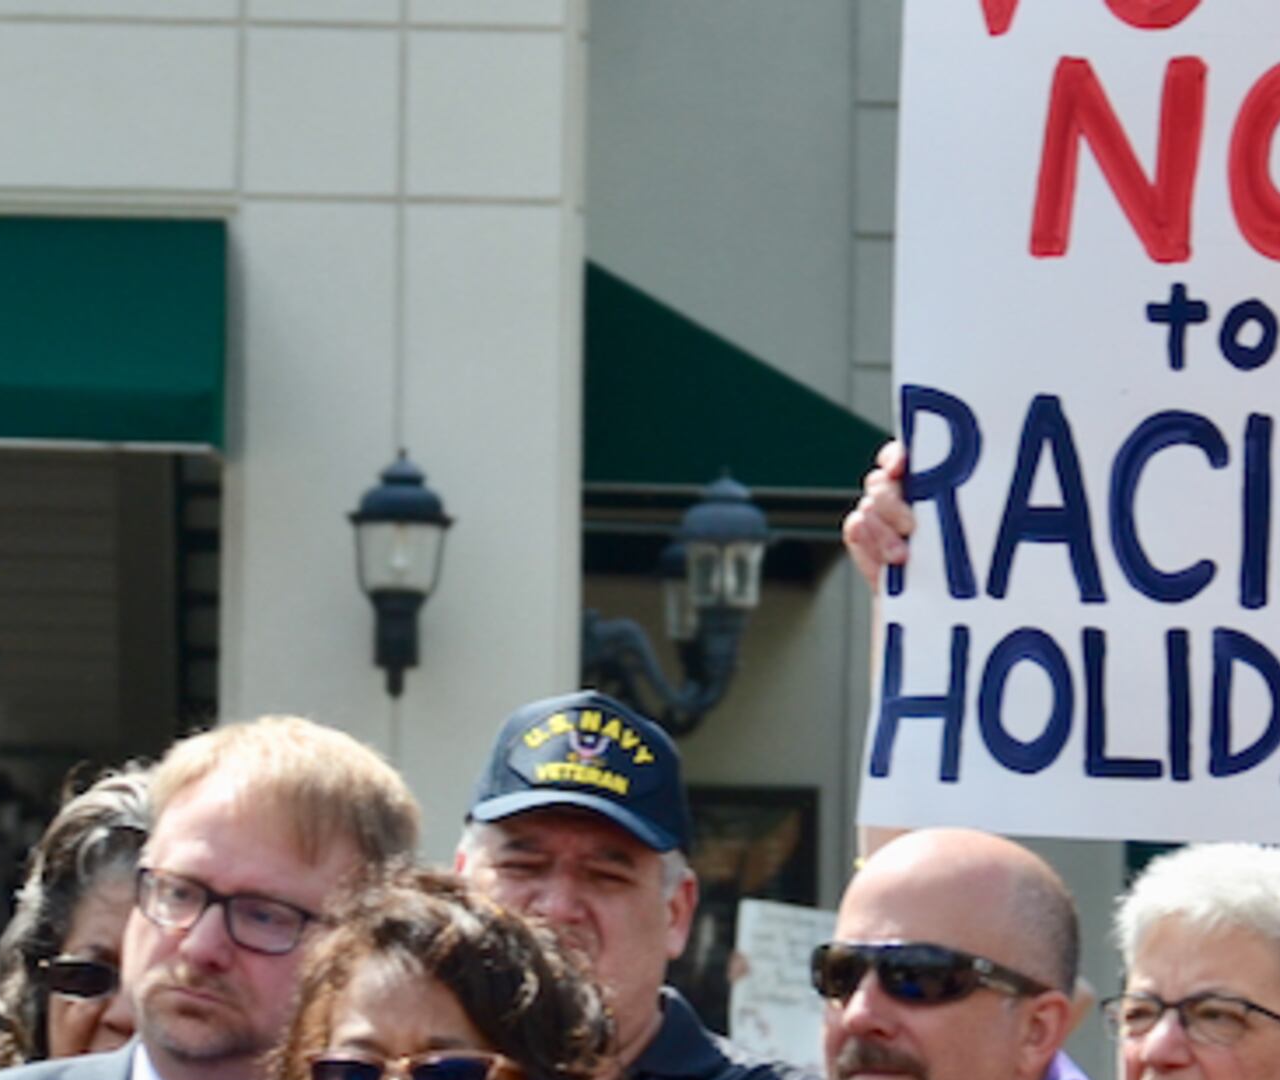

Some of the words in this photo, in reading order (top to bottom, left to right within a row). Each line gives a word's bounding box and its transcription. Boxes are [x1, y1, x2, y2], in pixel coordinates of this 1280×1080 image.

[1145, 282, 1280, 371] to
[578, 709, 655, 764] NAVY
[535, 761, 629, 795] VETERAN
